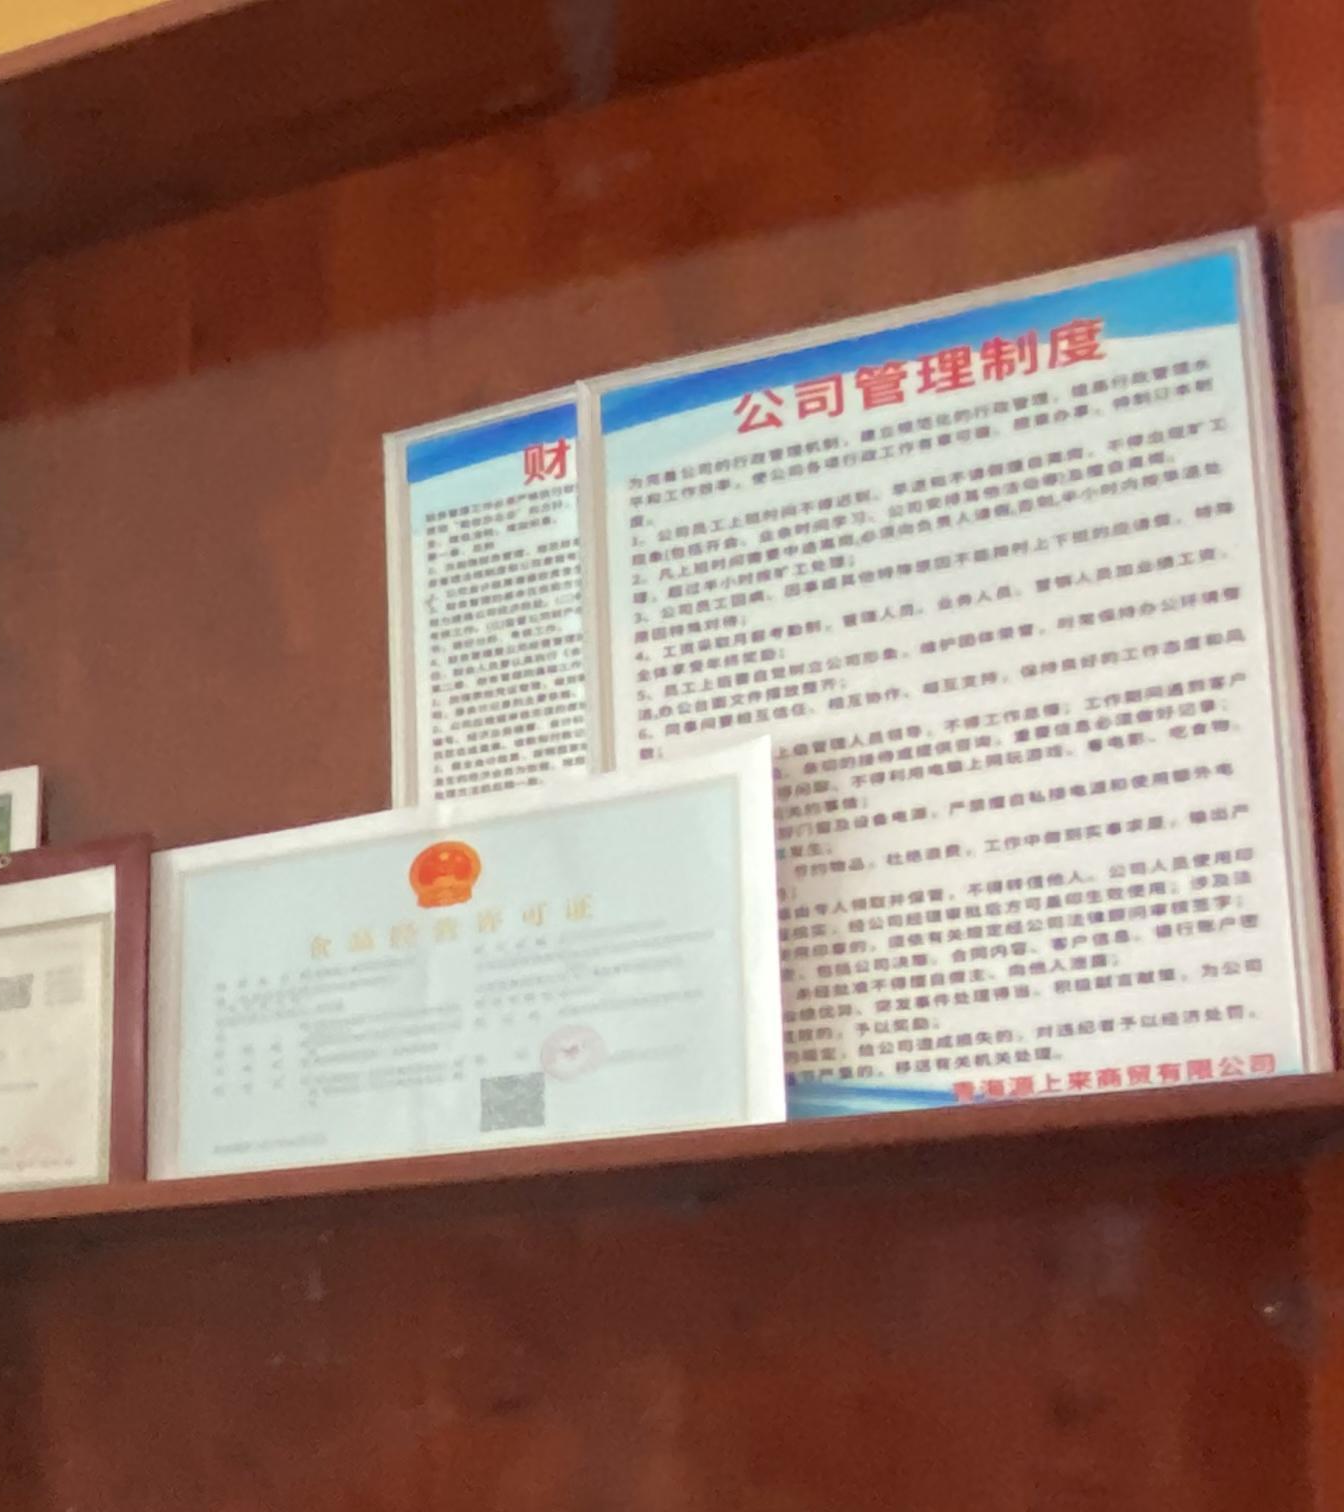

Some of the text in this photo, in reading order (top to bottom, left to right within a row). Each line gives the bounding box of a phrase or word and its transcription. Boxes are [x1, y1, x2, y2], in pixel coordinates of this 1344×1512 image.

[731, 313, 1108, 441] 公司管理制度
[523, 437, 571, 486] 财
[310, 893, 593, 962] 食品经营许可证
